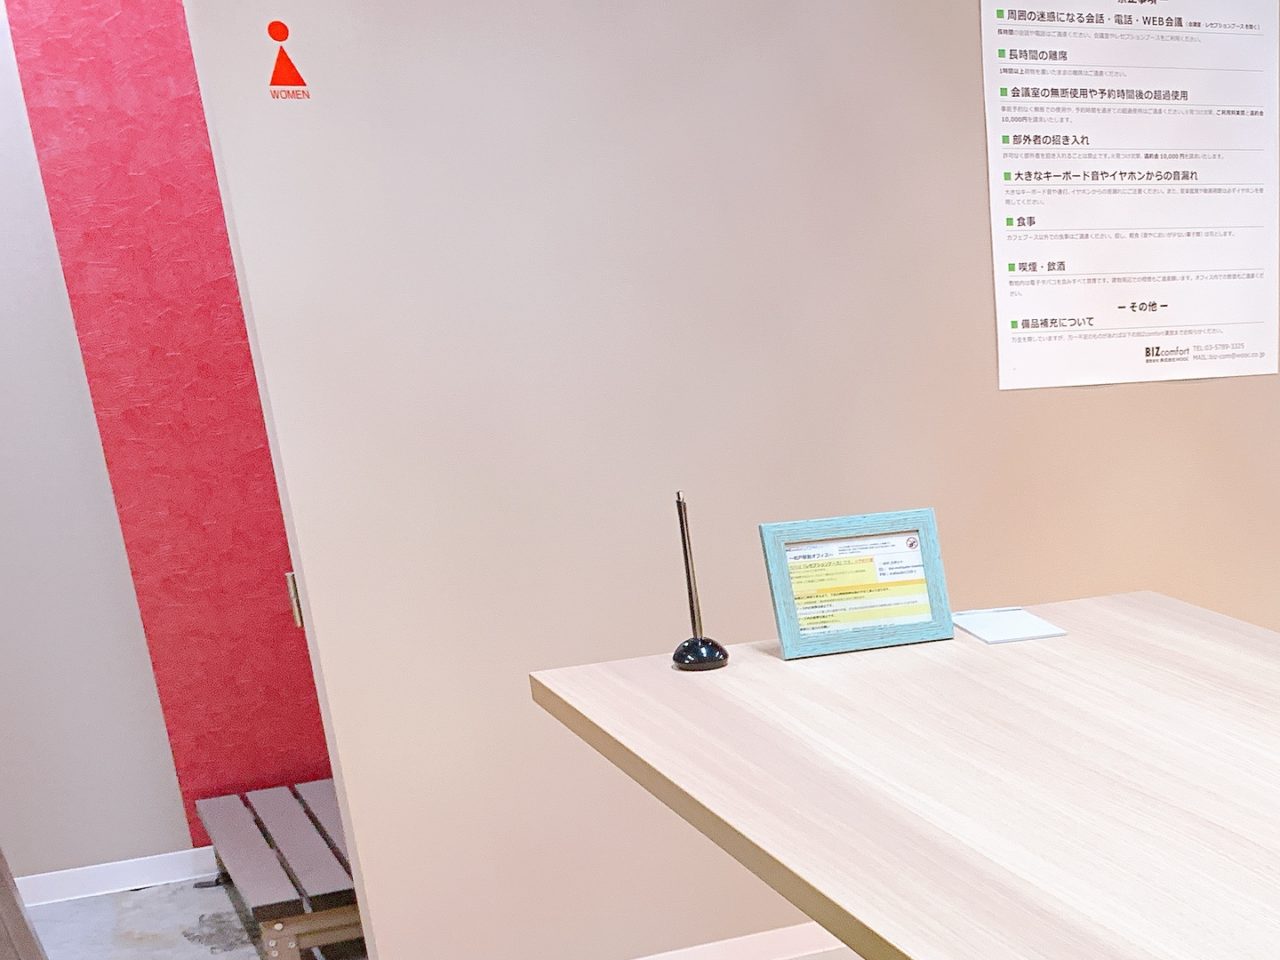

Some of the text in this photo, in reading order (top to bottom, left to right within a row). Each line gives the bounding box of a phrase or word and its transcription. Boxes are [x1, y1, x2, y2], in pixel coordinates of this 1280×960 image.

[1009, 49, 1068, 61] 長時間の離席
[270, 90, 310, 99] WOMEN
[1011, 87, 1188, 101] 会議室の無断使用や予約時間後の超過使用
[1013, 134, 1090, 145] 部外者の招き入れ
[1014, 171, 1198, 181] 大きなキーボード音やイヤホンからの音漏れ
[1017, 216, 1036, 227] 食事
[1018, 261, 1066, 272] 喫煙・飲酒
[1021, 317, 1094, 329] 備品補充について
